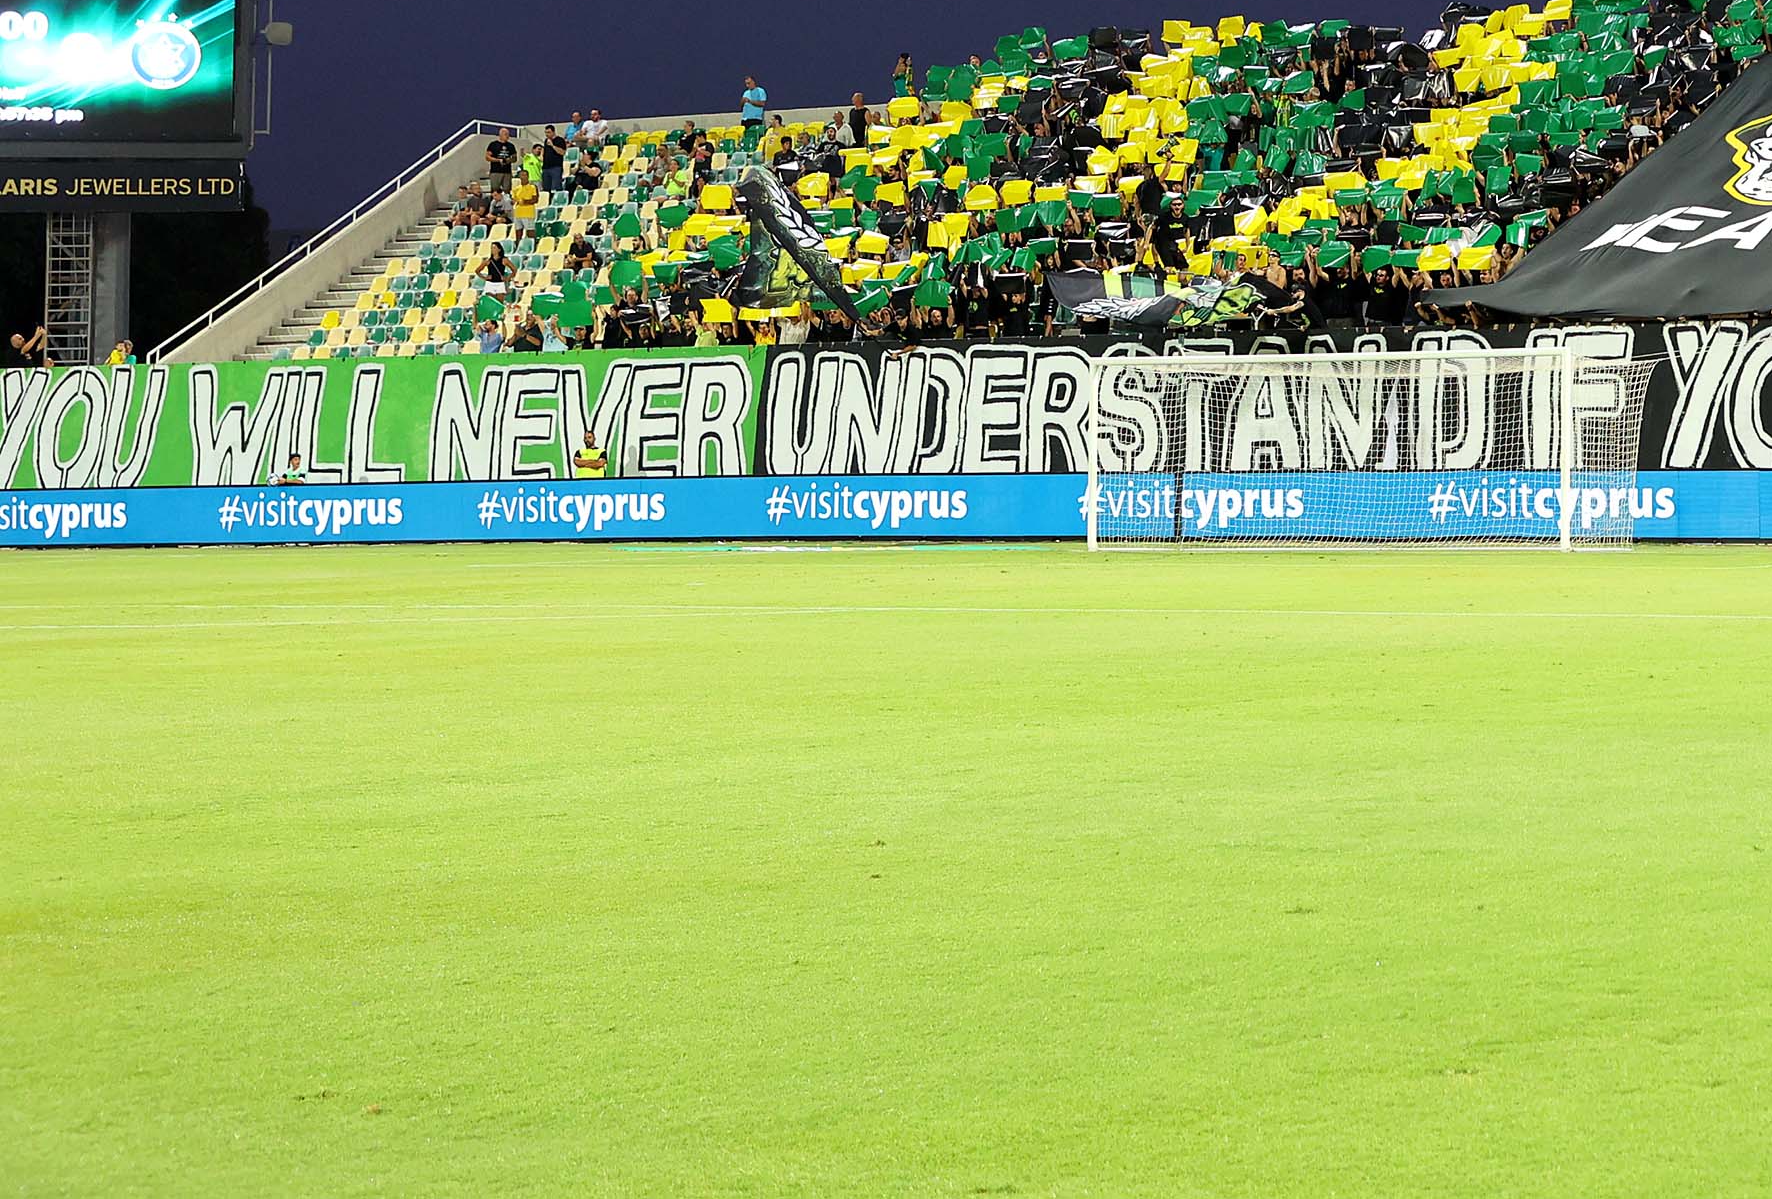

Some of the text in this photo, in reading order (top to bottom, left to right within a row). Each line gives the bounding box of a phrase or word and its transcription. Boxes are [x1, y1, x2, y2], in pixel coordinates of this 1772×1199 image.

[0, 178, 235, 195] ARIS JEWELLERS LTD
[0, 363, 168, 489] YOU
[190, 362, 406, 486] WILL
[431, 356, 755, 481] NEVER
[1526, 326, 1636, 469] IF
[218, 493, 403, 535] #visitcyprus
[477, 489, 666, 531] #visitcyprus
[766, 484, 968, 529] #visitcyprus
